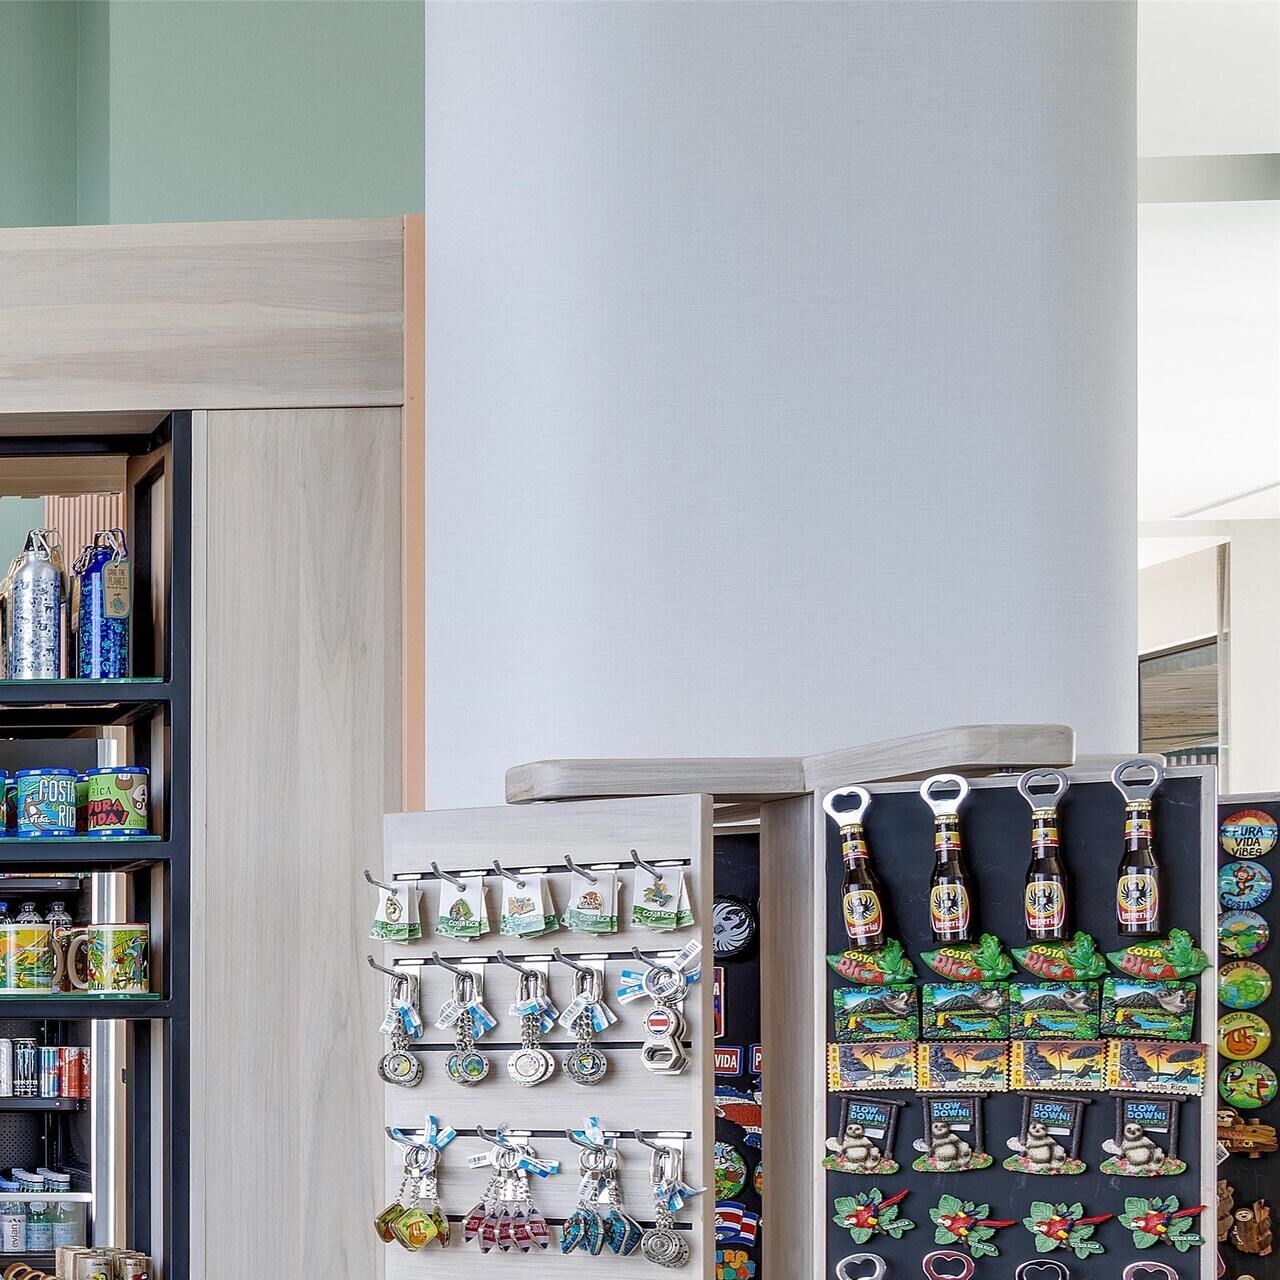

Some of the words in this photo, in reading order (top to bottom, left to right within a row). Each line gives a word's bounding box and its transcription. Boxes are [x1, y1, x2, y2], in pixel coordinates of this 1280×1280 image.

[1235, 838, 1262, 848] VIDA
[1232, 846, 1262, 857] VIBES
[939, 948, 973, 962] COSTA
[1127, 944, 1162, 958] COSTA
[934, 954, 984, 980] RICA
[1123, 952, 1177, 980] RICA
[715, 1054, 738, 1070] VIDA
[1051, 1079, 1072, 1087] Costa
[1074, 1079, 1092, 1087] Rica
[933, 1102, 961, 1110] SLOW
[1127, 1103, 1158, 1112] SLOW
[934, 1109, 970, 1118] DOWN!
[1127, 1111, 1166, 1120] DOWN!
